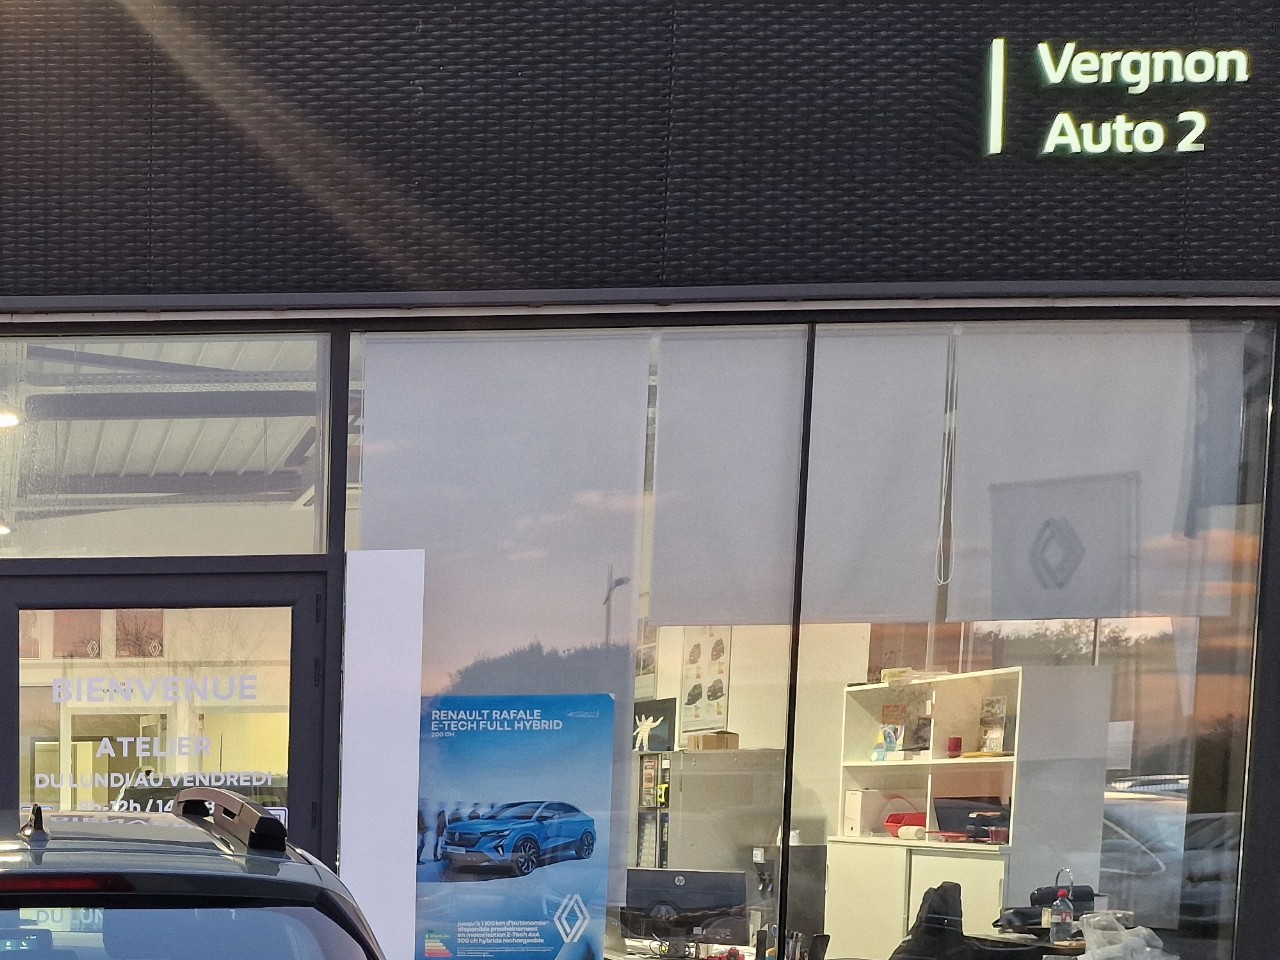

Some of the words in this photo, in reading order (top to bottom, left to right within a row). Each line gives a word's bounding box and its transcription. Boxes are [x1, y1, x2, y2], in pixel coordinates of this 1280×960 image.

[1038, 42, 1249, 94] Vergnon
[1042, 112, 1166, 153] Auto
[1176, 111, 1206, 152] 2
[52, 675, 257, 703] BIENVENUE
[431, 710, 491, 721] RENAULT
[492, 710, 542, 720] RAFALE
[431, 721, 477, 731] E-TECH
[480, 720, 511, 731] FULL
[515, 720, 563, 730] HYBRID
[96, 737, 211, 758] ATELIER
[35, 774, 63, 788] DU
[69, 773, 131, 788] LUNDI
[134, 773, 164, 787] AU
[169, 771, 272, 787] VENDREDI
